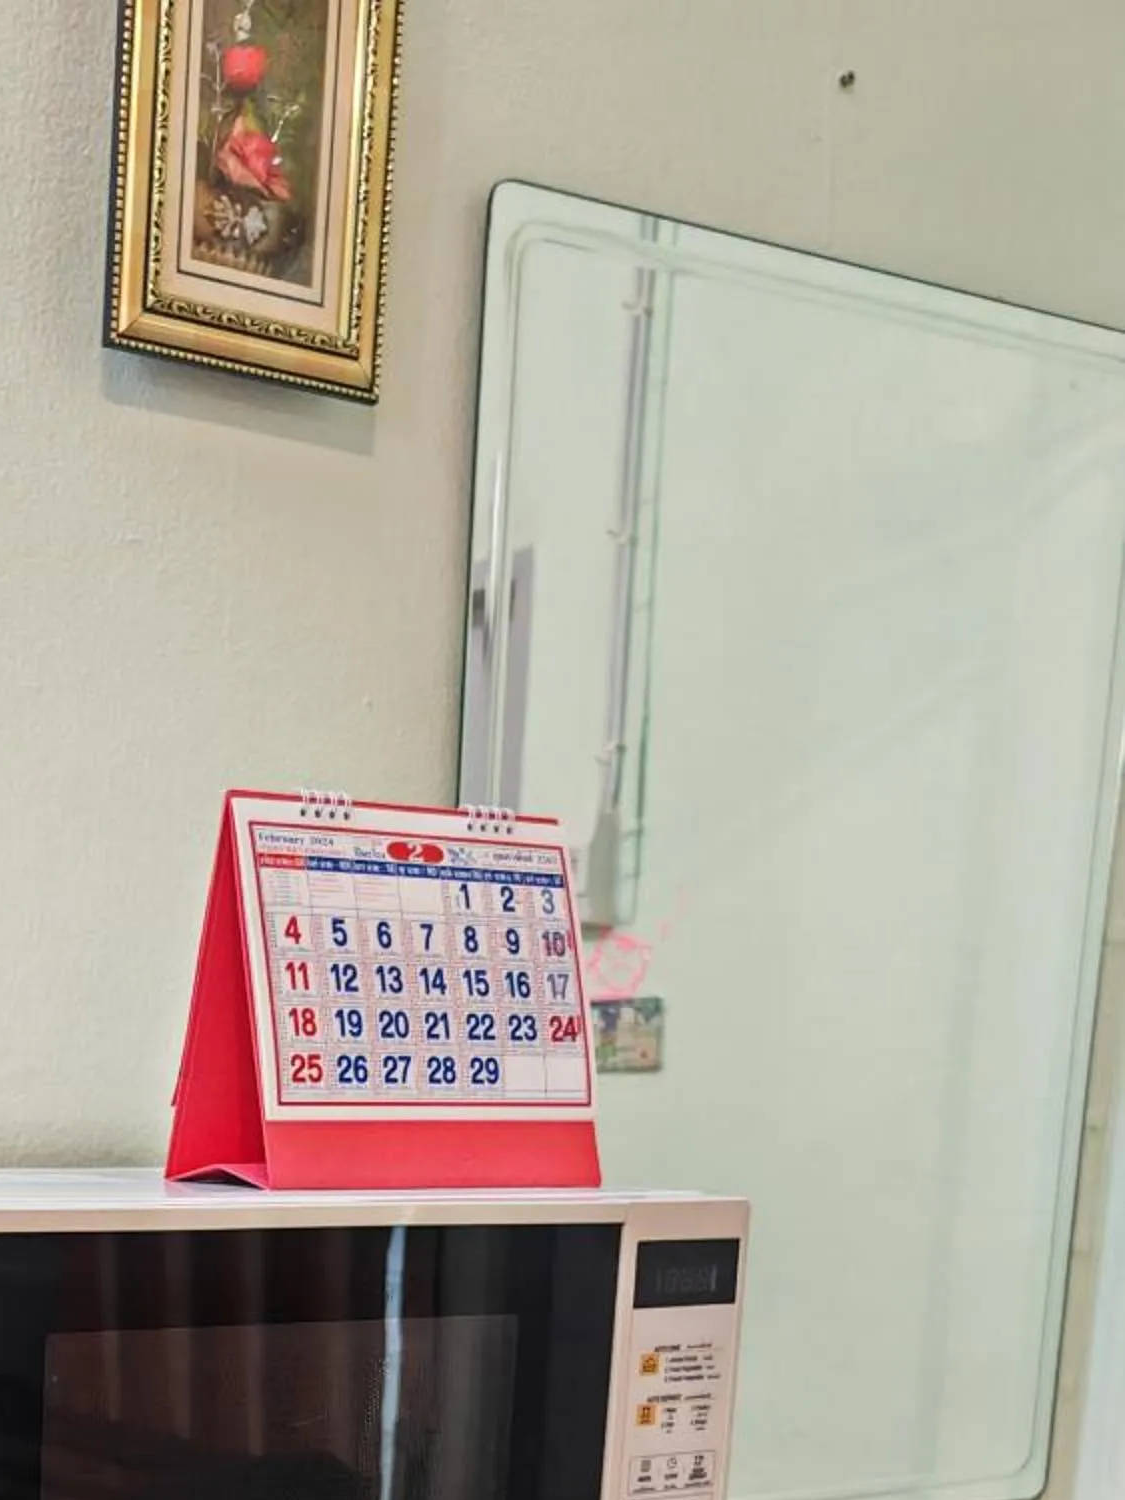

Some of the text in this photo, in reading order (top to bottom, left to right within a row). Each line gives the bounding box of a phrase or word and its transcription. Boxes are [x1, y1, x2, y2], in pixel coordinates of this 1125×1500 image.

[409, 844, 422, 859] 2
[459, 883, 556, 915] 1 2 3
[284, 916, 566, 958] 4 5 6 7 8 9 10
[285, 961, 570, 1000] 11 12 13 14 15 16 17
[289, 1007, 577, 1043] 18 19 20 21 22 23 24
[290, 1054, 500, 1085] 25 26 27 28 29
